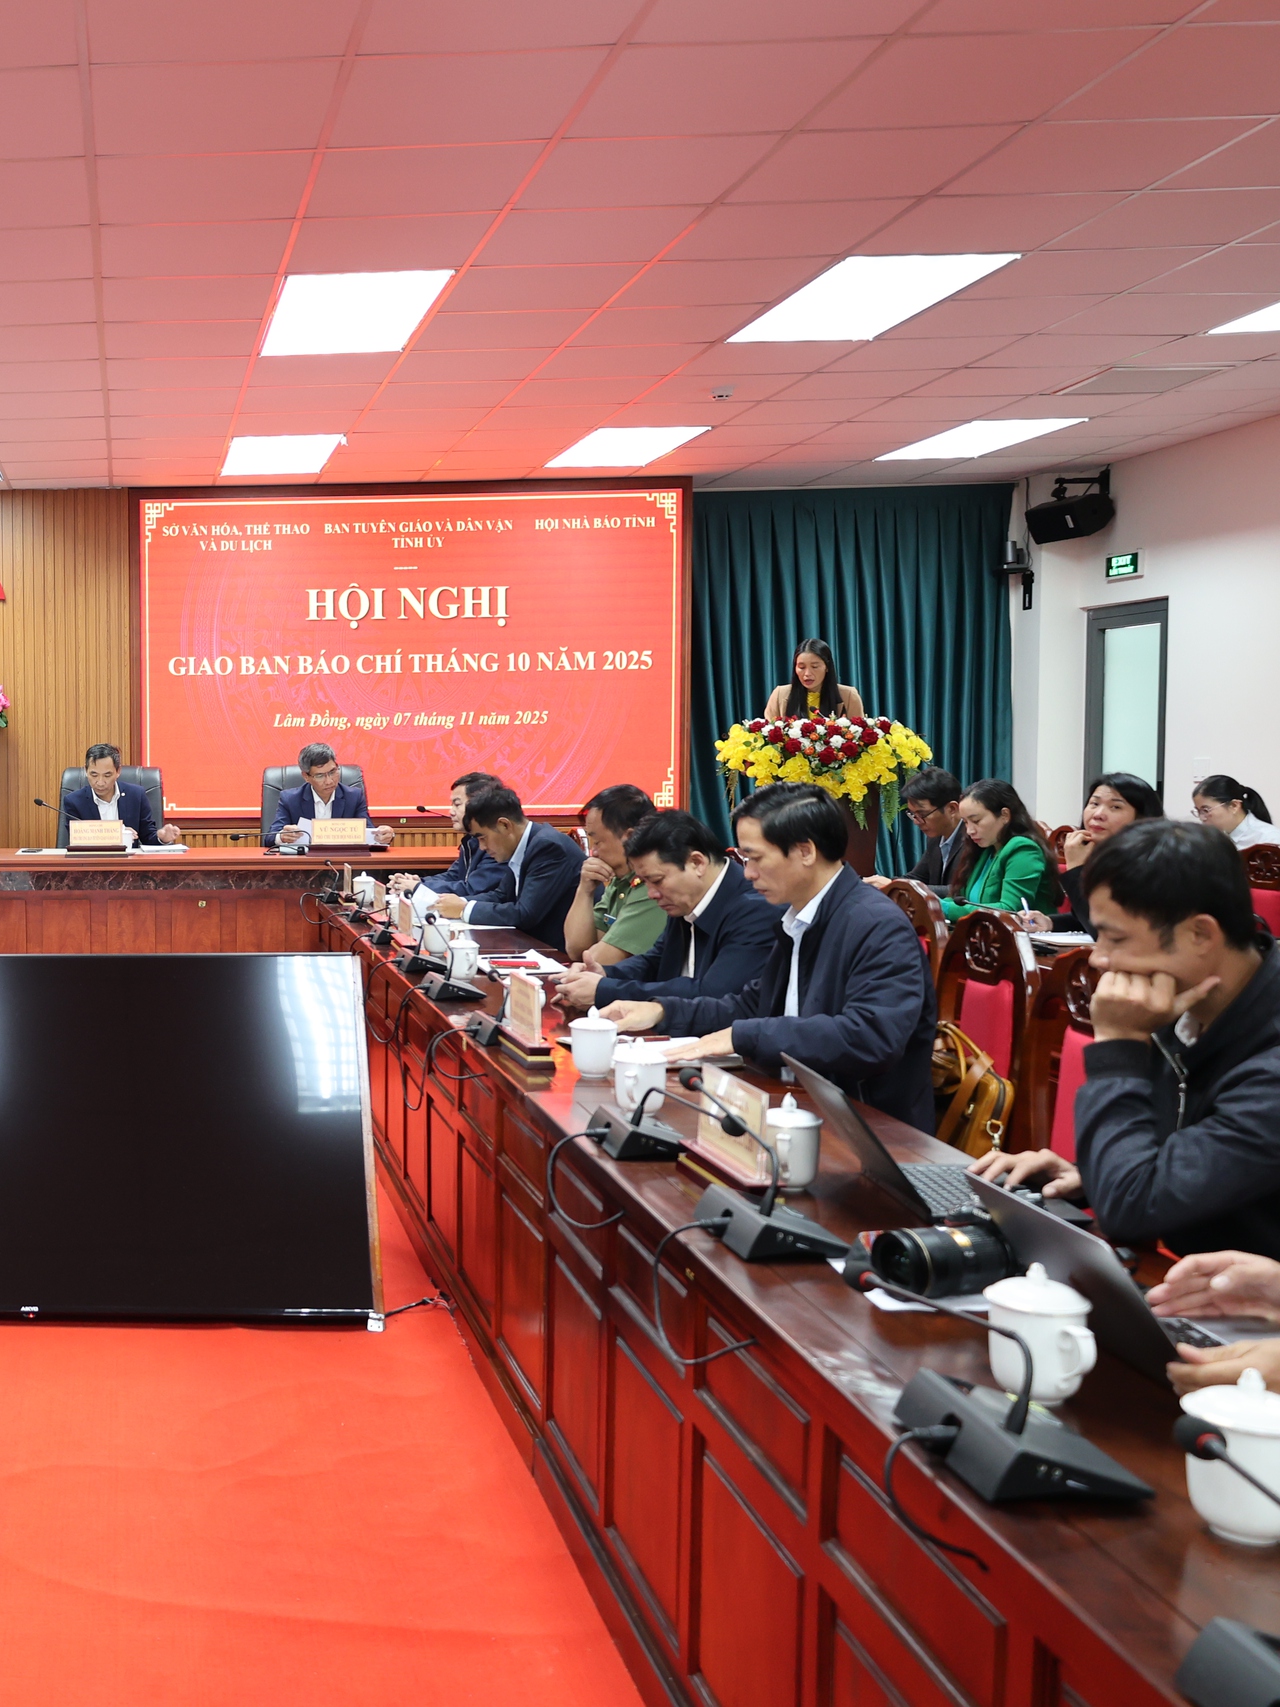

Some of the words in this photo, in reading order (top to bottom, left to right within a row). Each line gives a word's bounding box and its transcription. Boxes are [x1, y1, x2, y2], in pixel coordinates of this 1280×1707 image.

[162, 523, 179, 536] SỞ
[182, 523, 208, 536] VĂN
[211, 522, 242, 537] HÓA,
[273, 523, 310, 535] THAO
[324, 523, 350, 534] BAN
[353, 519, 396, 534] TUYÊN
[399, 519, 433, 533] GIÁO
[436, 518, 453, 532] VÀ
[456, 518, 483, 532] DÂN
[486, 518, 513, 534] VẬN
[534, 518, 559, 532] HỘI
[562, 515, 590, 529] NHÀ
[593, 515, 621, 529] BÁO
[623, 514, 656, 528] TỈNH
[199, 538, 217, 552] VÀ
[220, 540, 238, 551] DU
[241, 539, 272, 553] LỊCH
[392, 535, 423, 549] TỈNH
[427, 534, 445, 548] ỦY
[1112, 555, 1132, 566] EXIT
[305, 582, 387, 630] HỘI
[397, 586, 510, 627] NGHỊ
[168, 656, 234, 676] GIAO
[239, 655, 290, 675] BAN
[297, 649, 350, 675] BÁO
[356, 648, 403, 674] CHÍ
[408, 648, 499, 673] THÁNG
[506, 652, 531, 672] 10
[536, 646, 596, 671] NĂM
[602, 650, 653, 670] 2025
[273, 713, 305, 728] Lâm
[309, 710, 351, 731] Đồng,
[355, 713, 390, 730] ngày
[393, 712, 412, 726] 07
[413, 712, 455, 729] tháng
[459, 712, 475, 726] 11
[478, 712, 510, 725] năm
[513, 711, 549, 725] 2025
